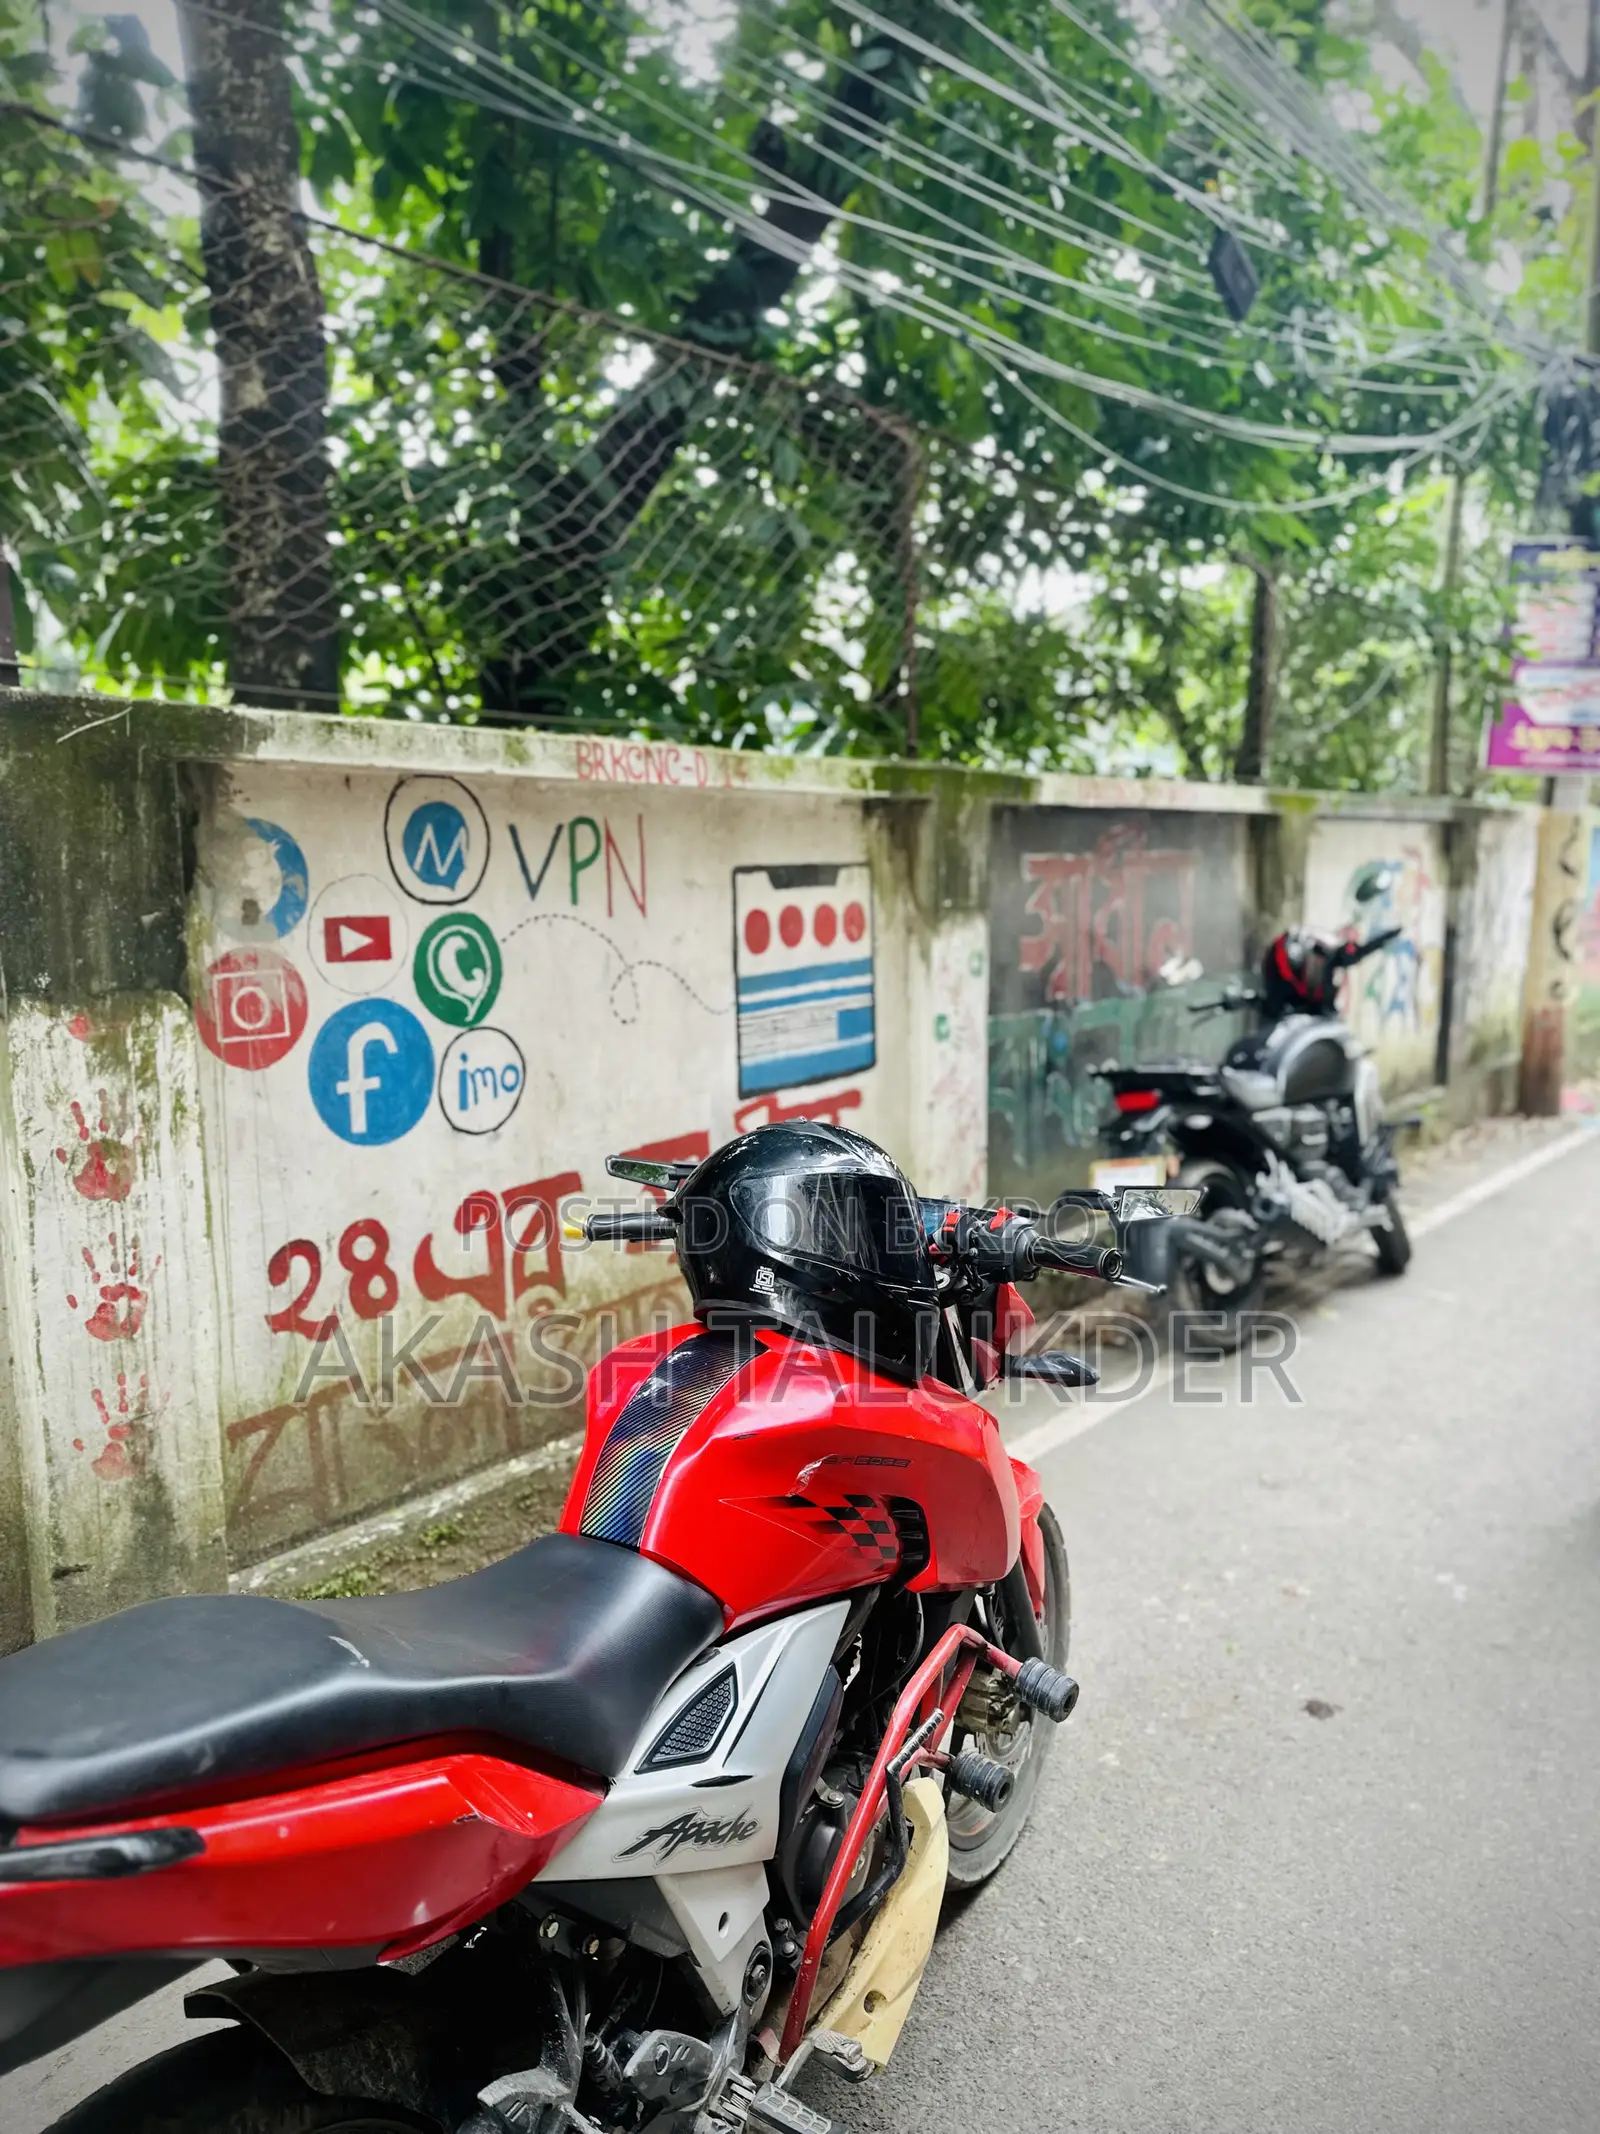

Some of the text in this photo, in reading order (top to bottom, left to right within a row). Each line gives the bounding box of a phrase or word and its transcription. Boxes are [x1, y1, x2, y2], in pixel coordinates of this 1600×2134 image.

[507, 812, 648, 919] VPN
[458, 1052, 521, 1111] imo
[615, 1804, 763, 1863] Apache
